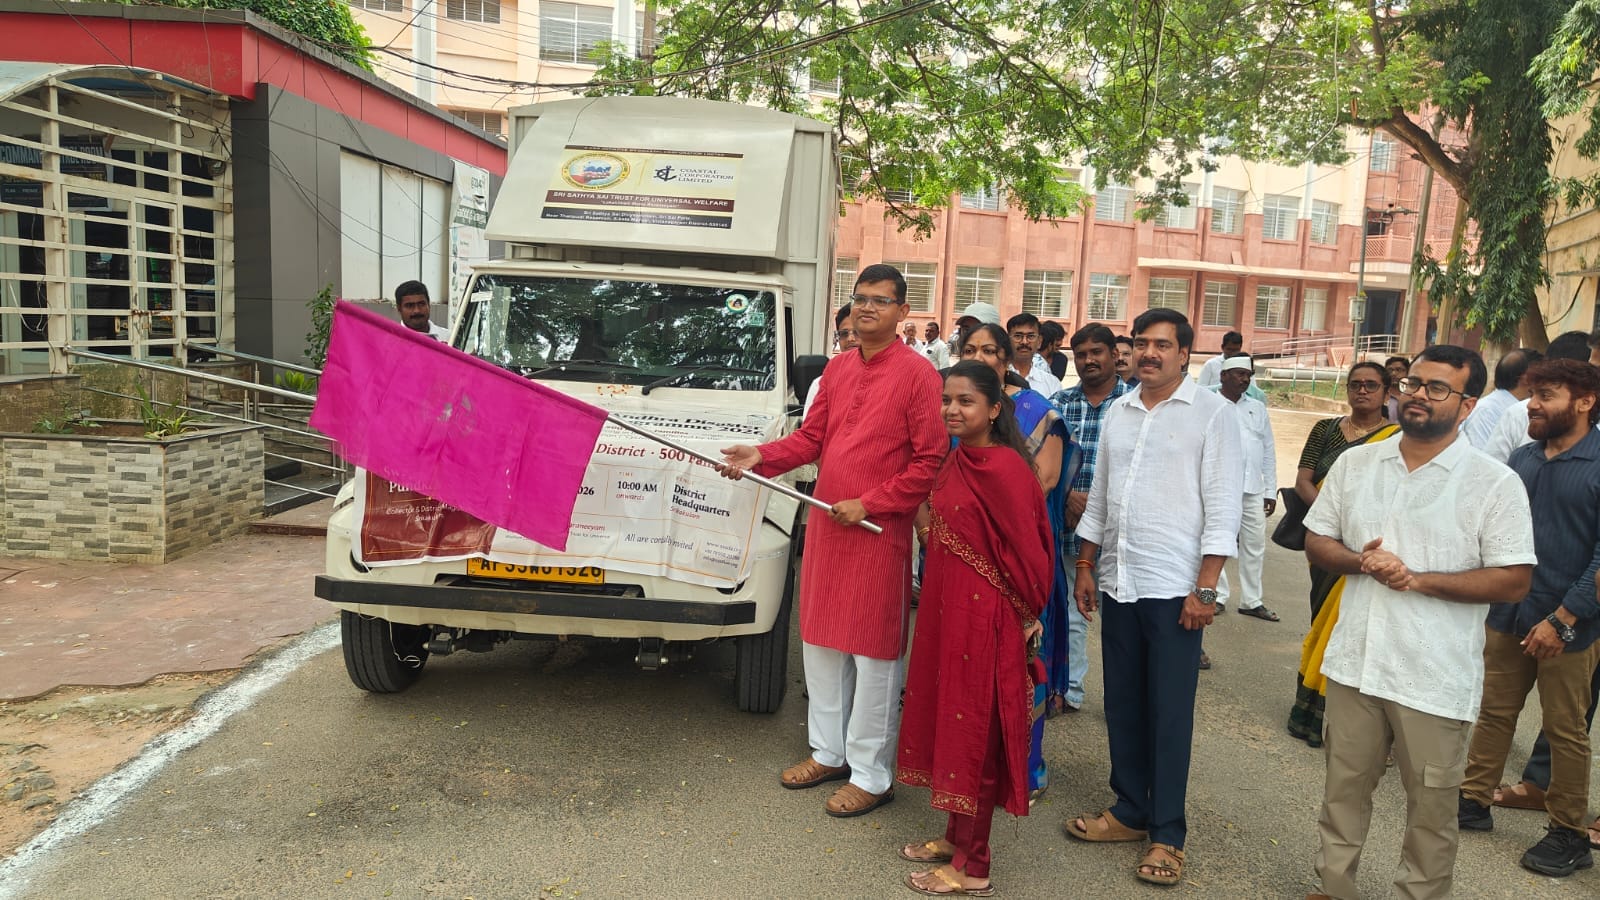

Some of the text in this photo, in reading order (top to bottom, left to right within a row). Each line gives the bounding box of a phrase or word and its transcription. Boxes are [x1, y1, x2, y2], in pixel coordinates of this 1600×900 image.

[0, 146, 43, 164] COMMAN
[651, 196, 692, 205] UNIVERSAL
[694, 199, 729, 207] WELFARE
[613, 412, 678, 423] Andhra
[685, 418, 763, 430] Disaster
[596, 443, 646, 458] District
[658, 448, 685, 462] 500
[577, 486, 595, 496] 026
[617, 480, 658, 493] 10:00 AM
[674, 484, 707, 501] District
[616, 493, 645, 501] onwards
[672, 494, 731, 518] Headquarters
[625, 530, 636, 542] All
